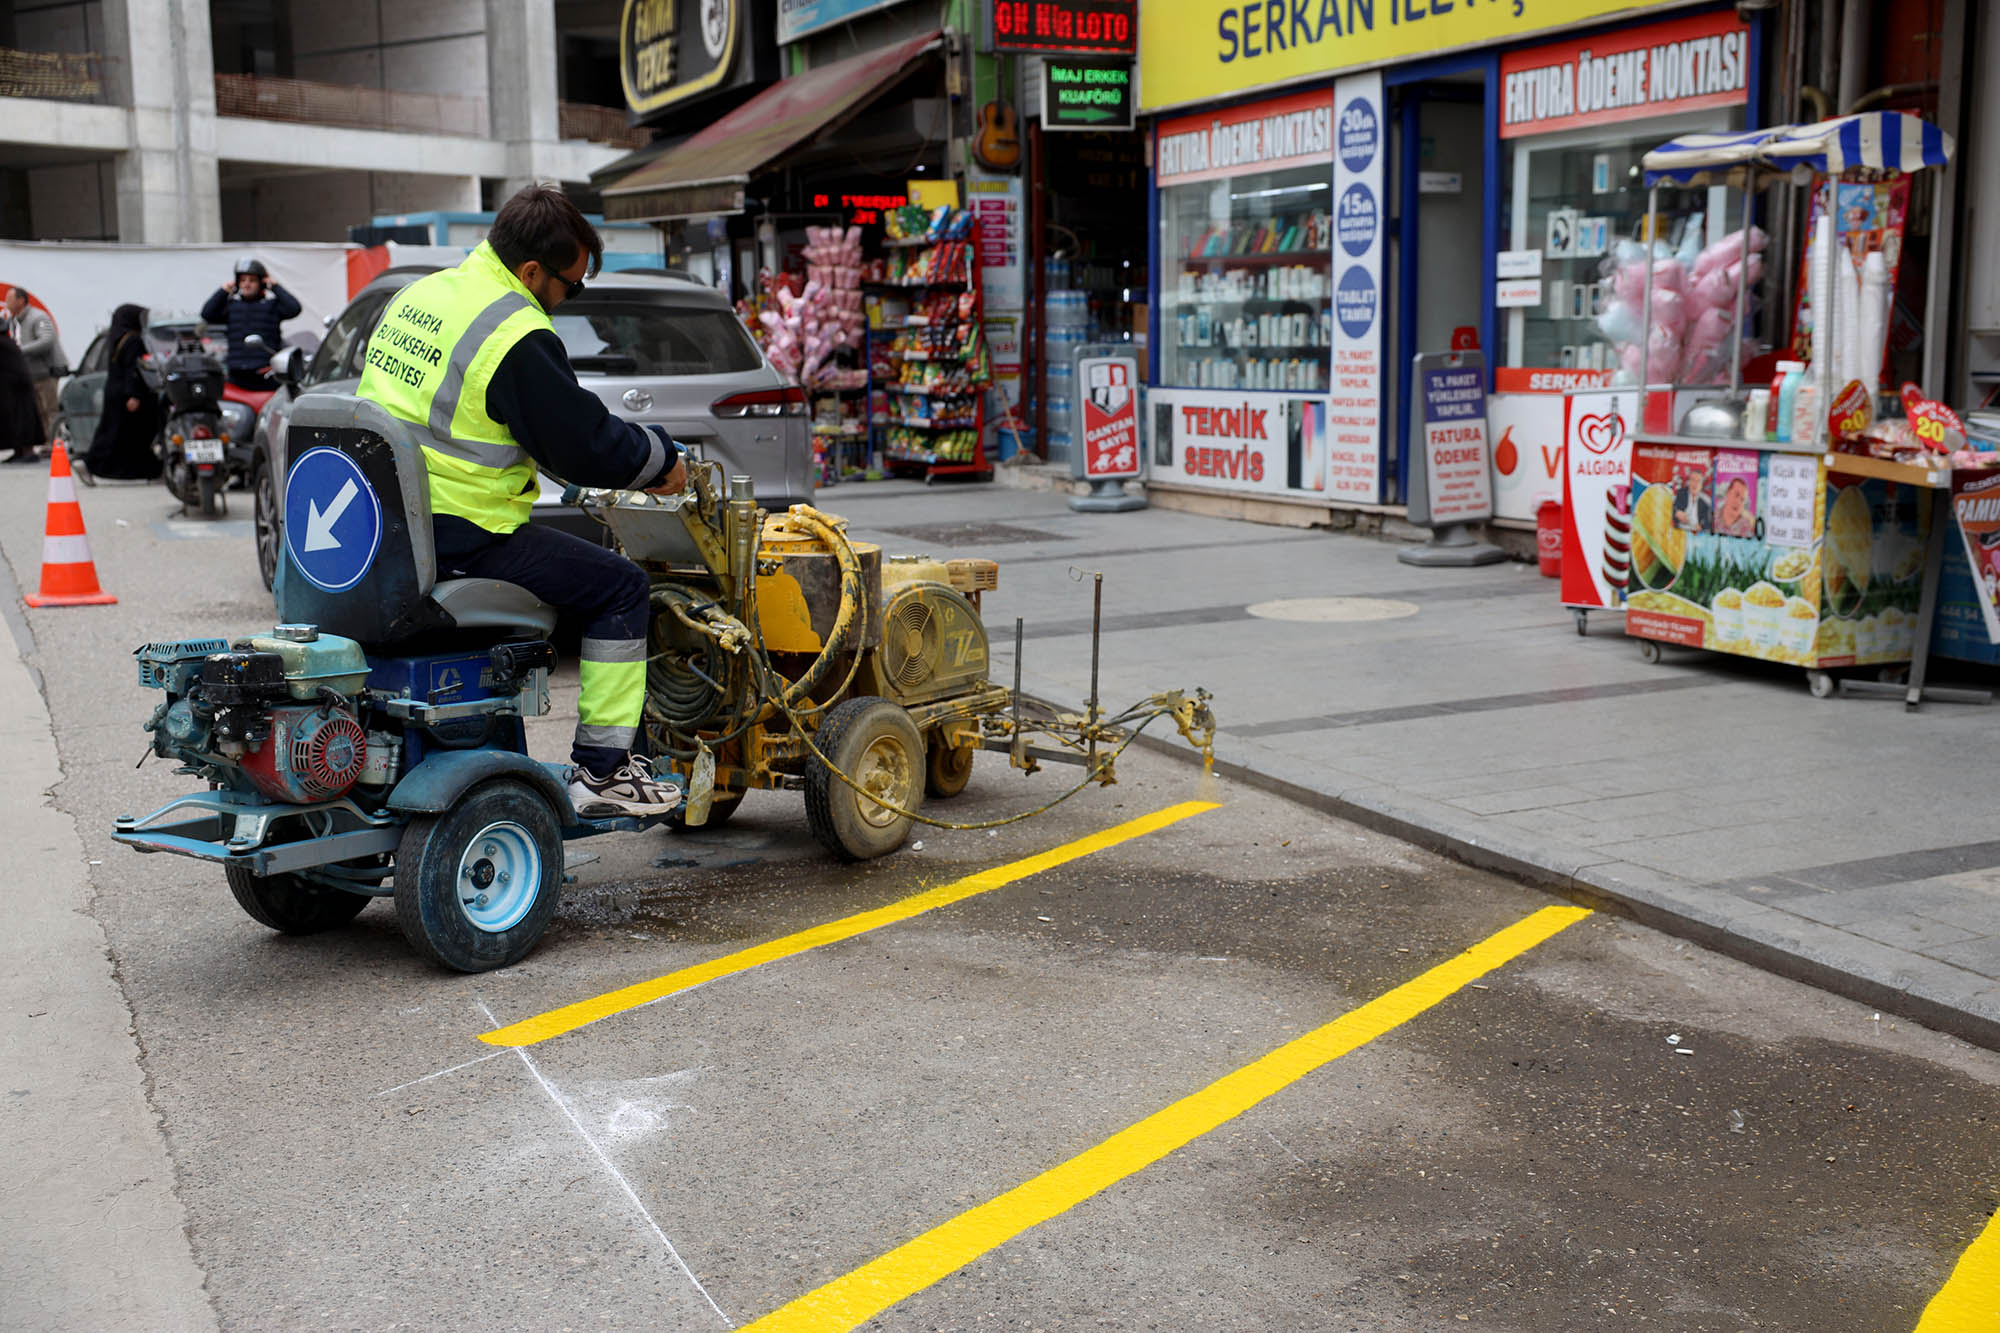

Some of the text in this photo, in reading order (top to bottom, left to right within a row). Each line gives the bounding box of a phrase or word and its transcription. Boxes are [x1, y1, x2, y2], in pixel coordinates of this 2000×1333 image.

[1218, 0, 1374, 63] SERKAN
[1505, 30, 1748, 125] FATURA ÖDEME NOKTASI
[1159, 105, 1332, 176] FATURA ÖDEME NOKTASI
[397, 304, 443, 336] SAKARYA
[1529, 372, 1604, 391] SERKAN
[1182, 402, 1268, 440] TEKNİK
[1431, 427, 1481, 445] FATURA
[1916, 416, 1945, 442] 20
[1184, 443, 1264, 482] SERVİS
[1434, 447, 1480, 465] ÖDEME
[1577, 459, 1625, 475] ALGIDA
